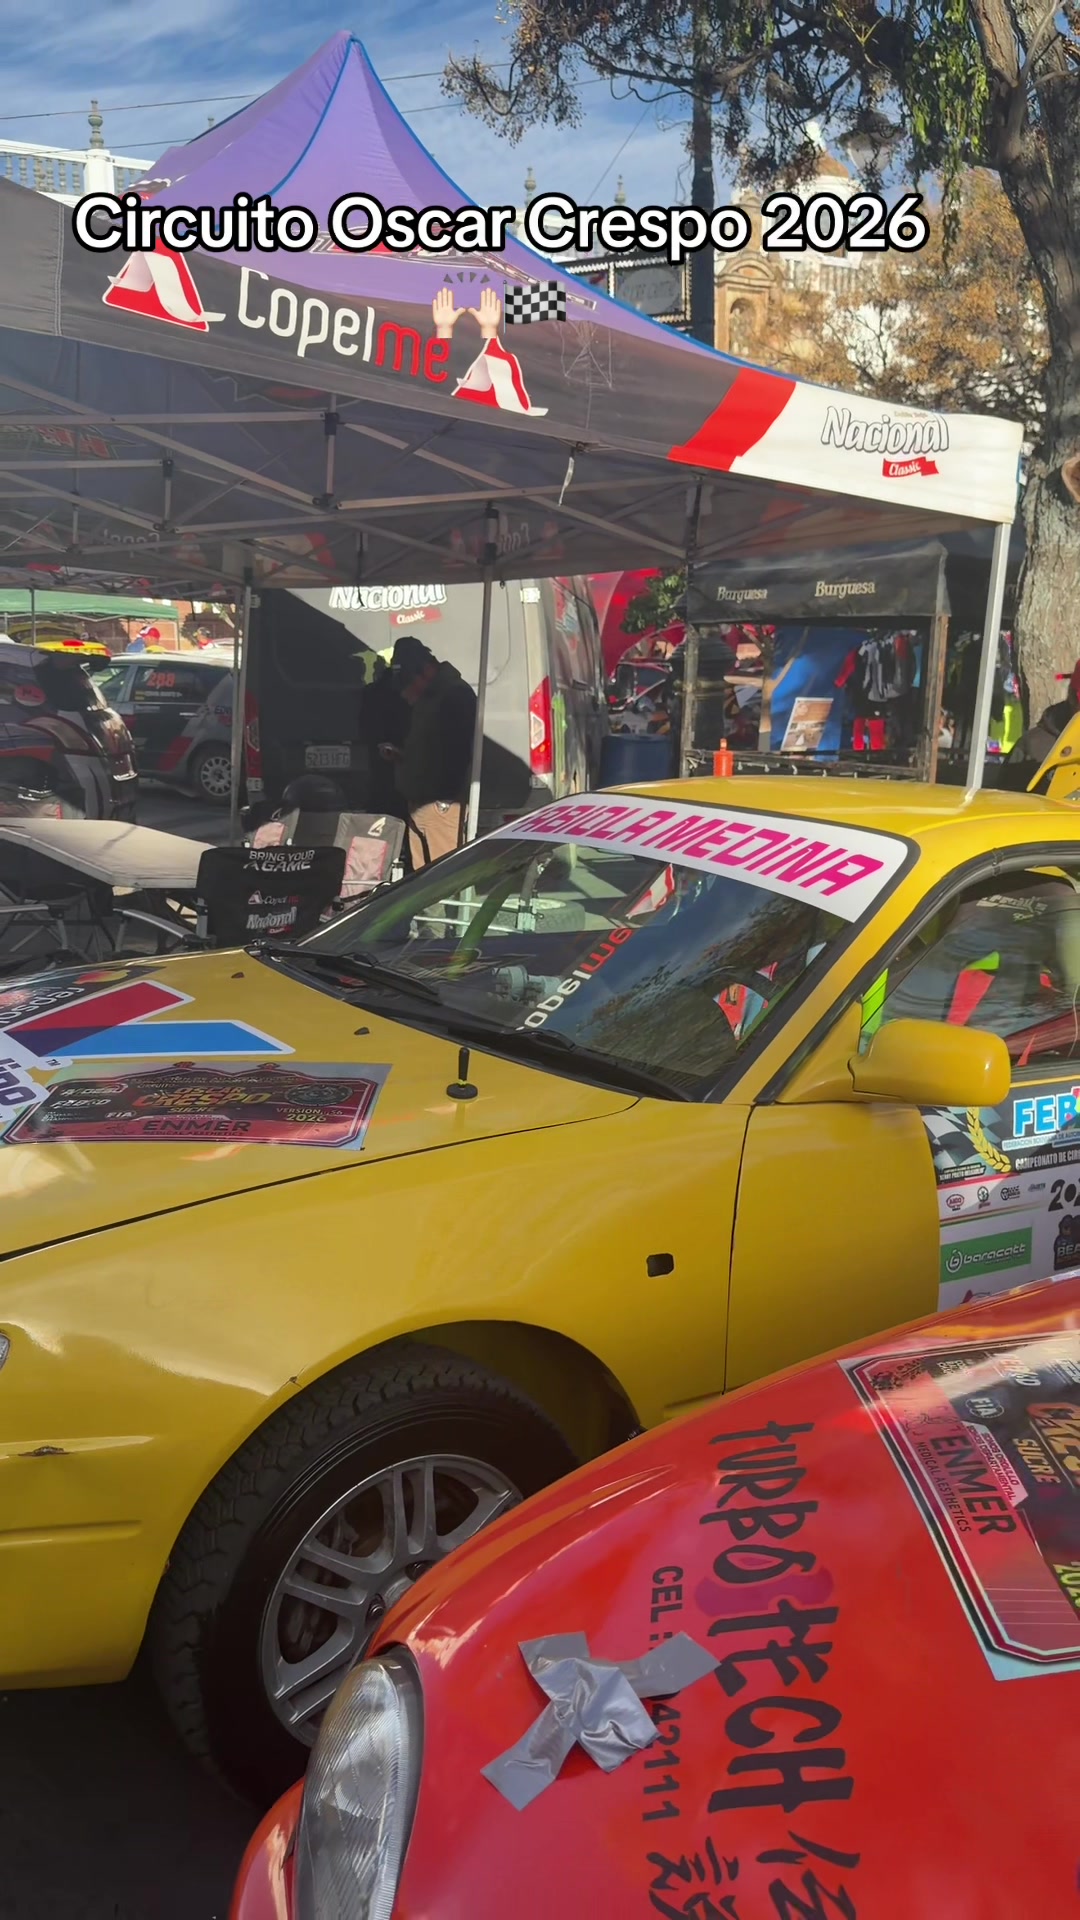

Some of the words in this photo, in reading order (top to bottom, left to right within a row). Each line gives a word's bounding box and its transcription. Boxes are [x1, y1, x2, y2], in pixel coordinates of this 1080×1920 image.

[238, 267, 450, 383] Copelme
[820, 405, 949, 454] Nacional
[888, 461, 922, 476] Classic
[716, 586, 768, 603] Burguesa
[814, 580, 876, 599] Burguesa
[249, 850, 285, 861] BRING
[288, 849, 315, 861] YOUR
[261, 861, 311, 872] GAME
[641, 815, 885, 897] MEDINA
[143, 1119, 252, 1133] ENMER
[286, 1113, 327, 1122] 2026
[970, 1397, 998, 1416] FIA
[1012, 1438, 1061, 1484] SUCRE
[915, 1442, 942, 1476] MEDICAL
[935, 1475, 972, 1533] AESTHETICS
[930, 1435, 1017, 1535] ENMER
[650, 1565, 683, 1623] CEL
[642, 1685, 682, 1822] 42111
